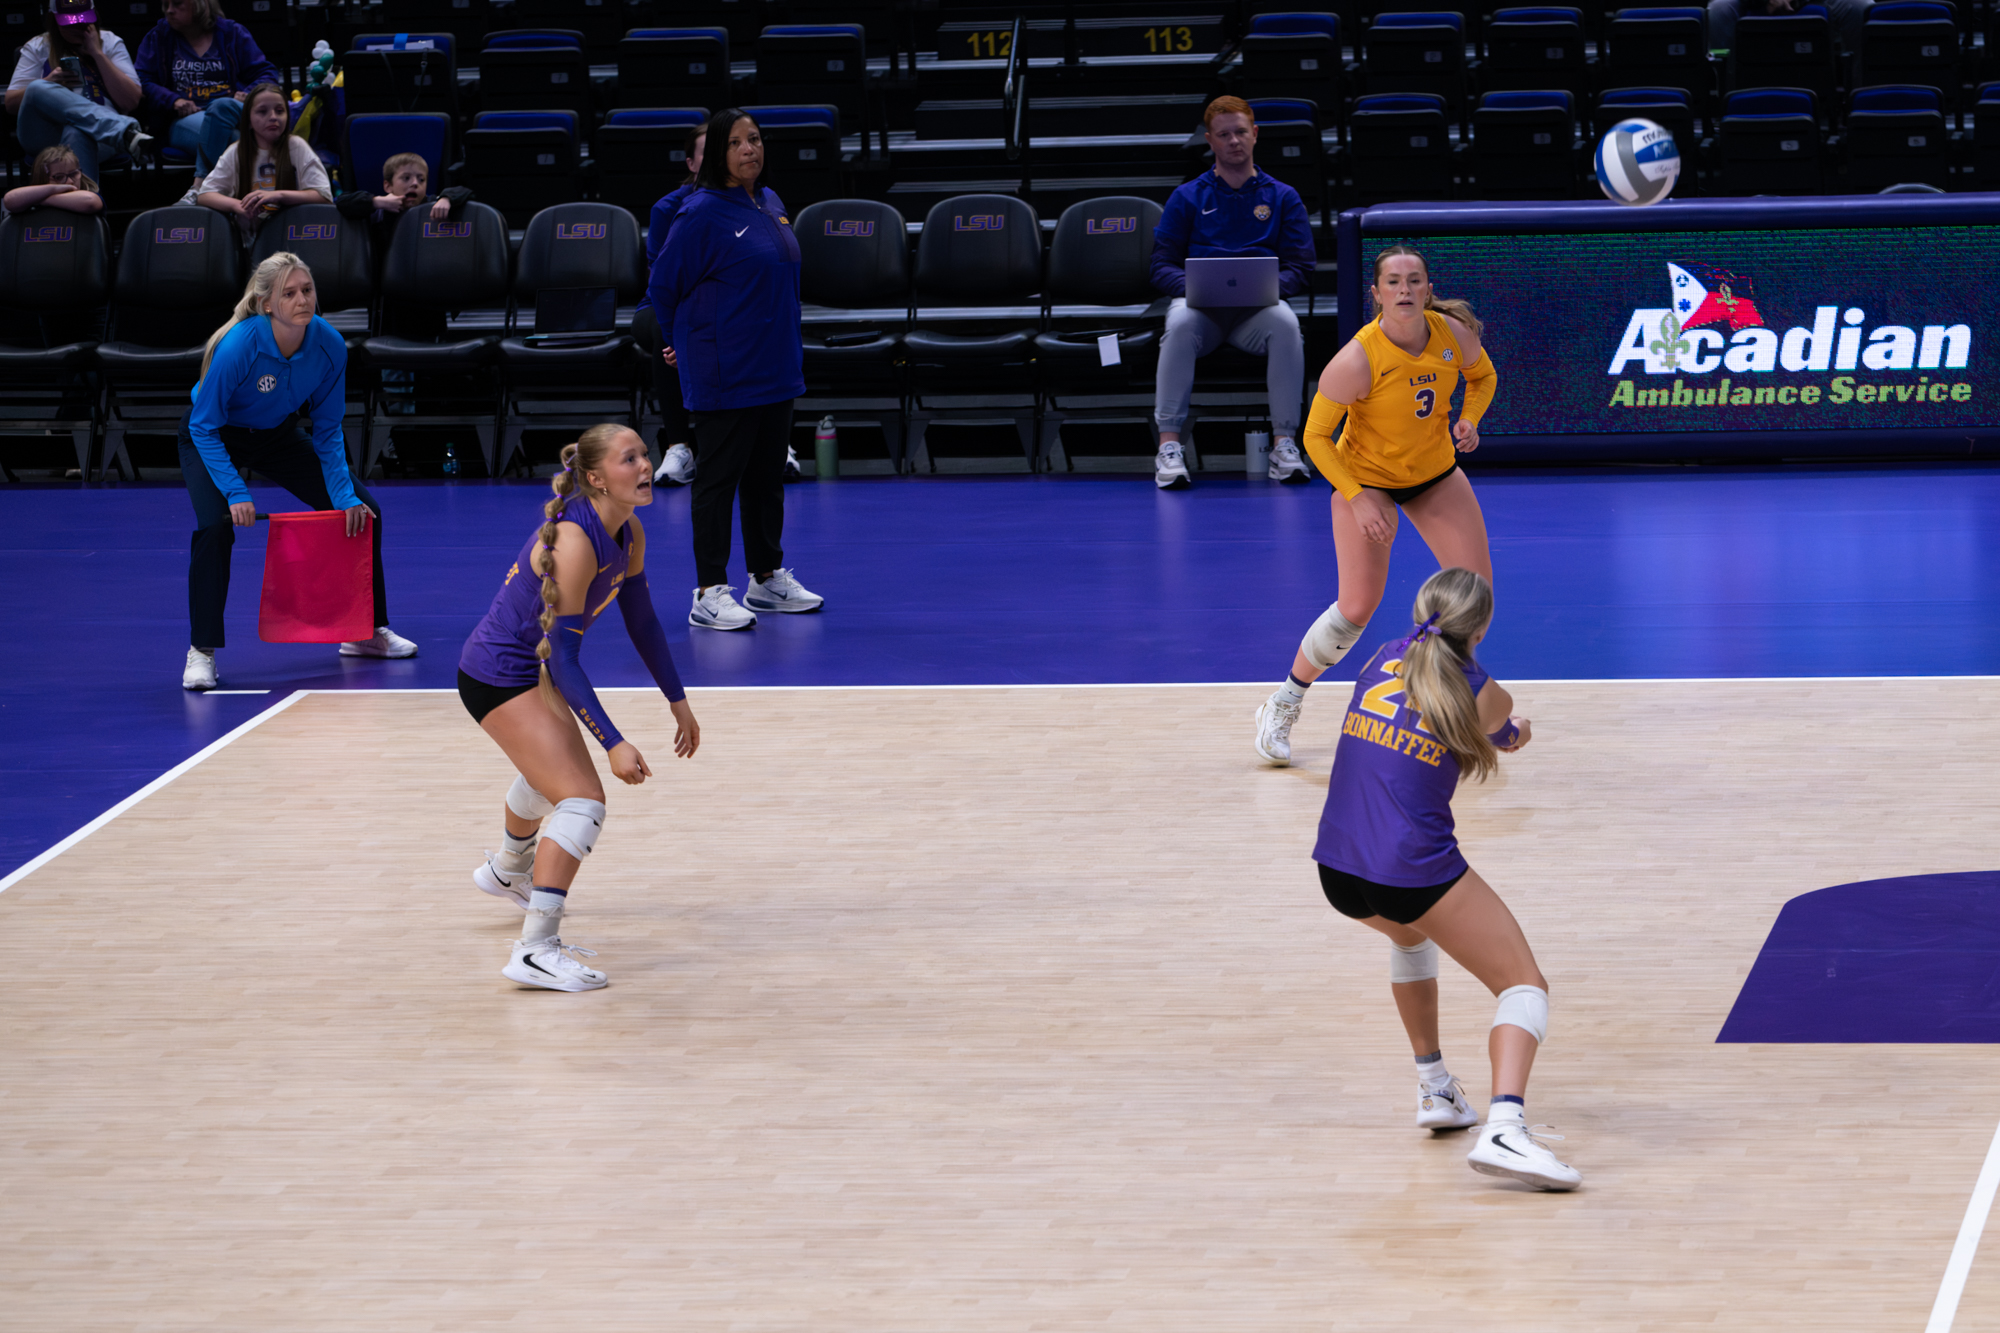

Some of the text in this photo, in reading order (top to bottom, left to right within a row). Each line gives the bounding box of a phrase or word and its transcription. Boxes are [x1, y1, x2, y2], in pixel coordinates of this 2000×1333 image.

[967, 31, 1012, 57] 112
[1144, 26, 1194, 53] 113
[422, 222, 472, 238] LSU
[557, 223, 607, 239] LSU
[824, 219, 875, 237] LSU
[954, 214, 1004, 231] LSU
[1086, 217, 1137, 235] LSU
[24, 226, 73, 243] LSU
[155, 227, 205, 244] LSU
[287, 224, 337, 241] LSU
[1607, 305, 1972, 375] Acadian
[258, 375, 276, 393] SEC
[1409, 372, 1437, 387] LSU
[1609, 376, 1972, 408] Ambulance Service
[1414, 387, 1436, 419] 3
[1342, 711, 1448, 767] BONNAFFEE
